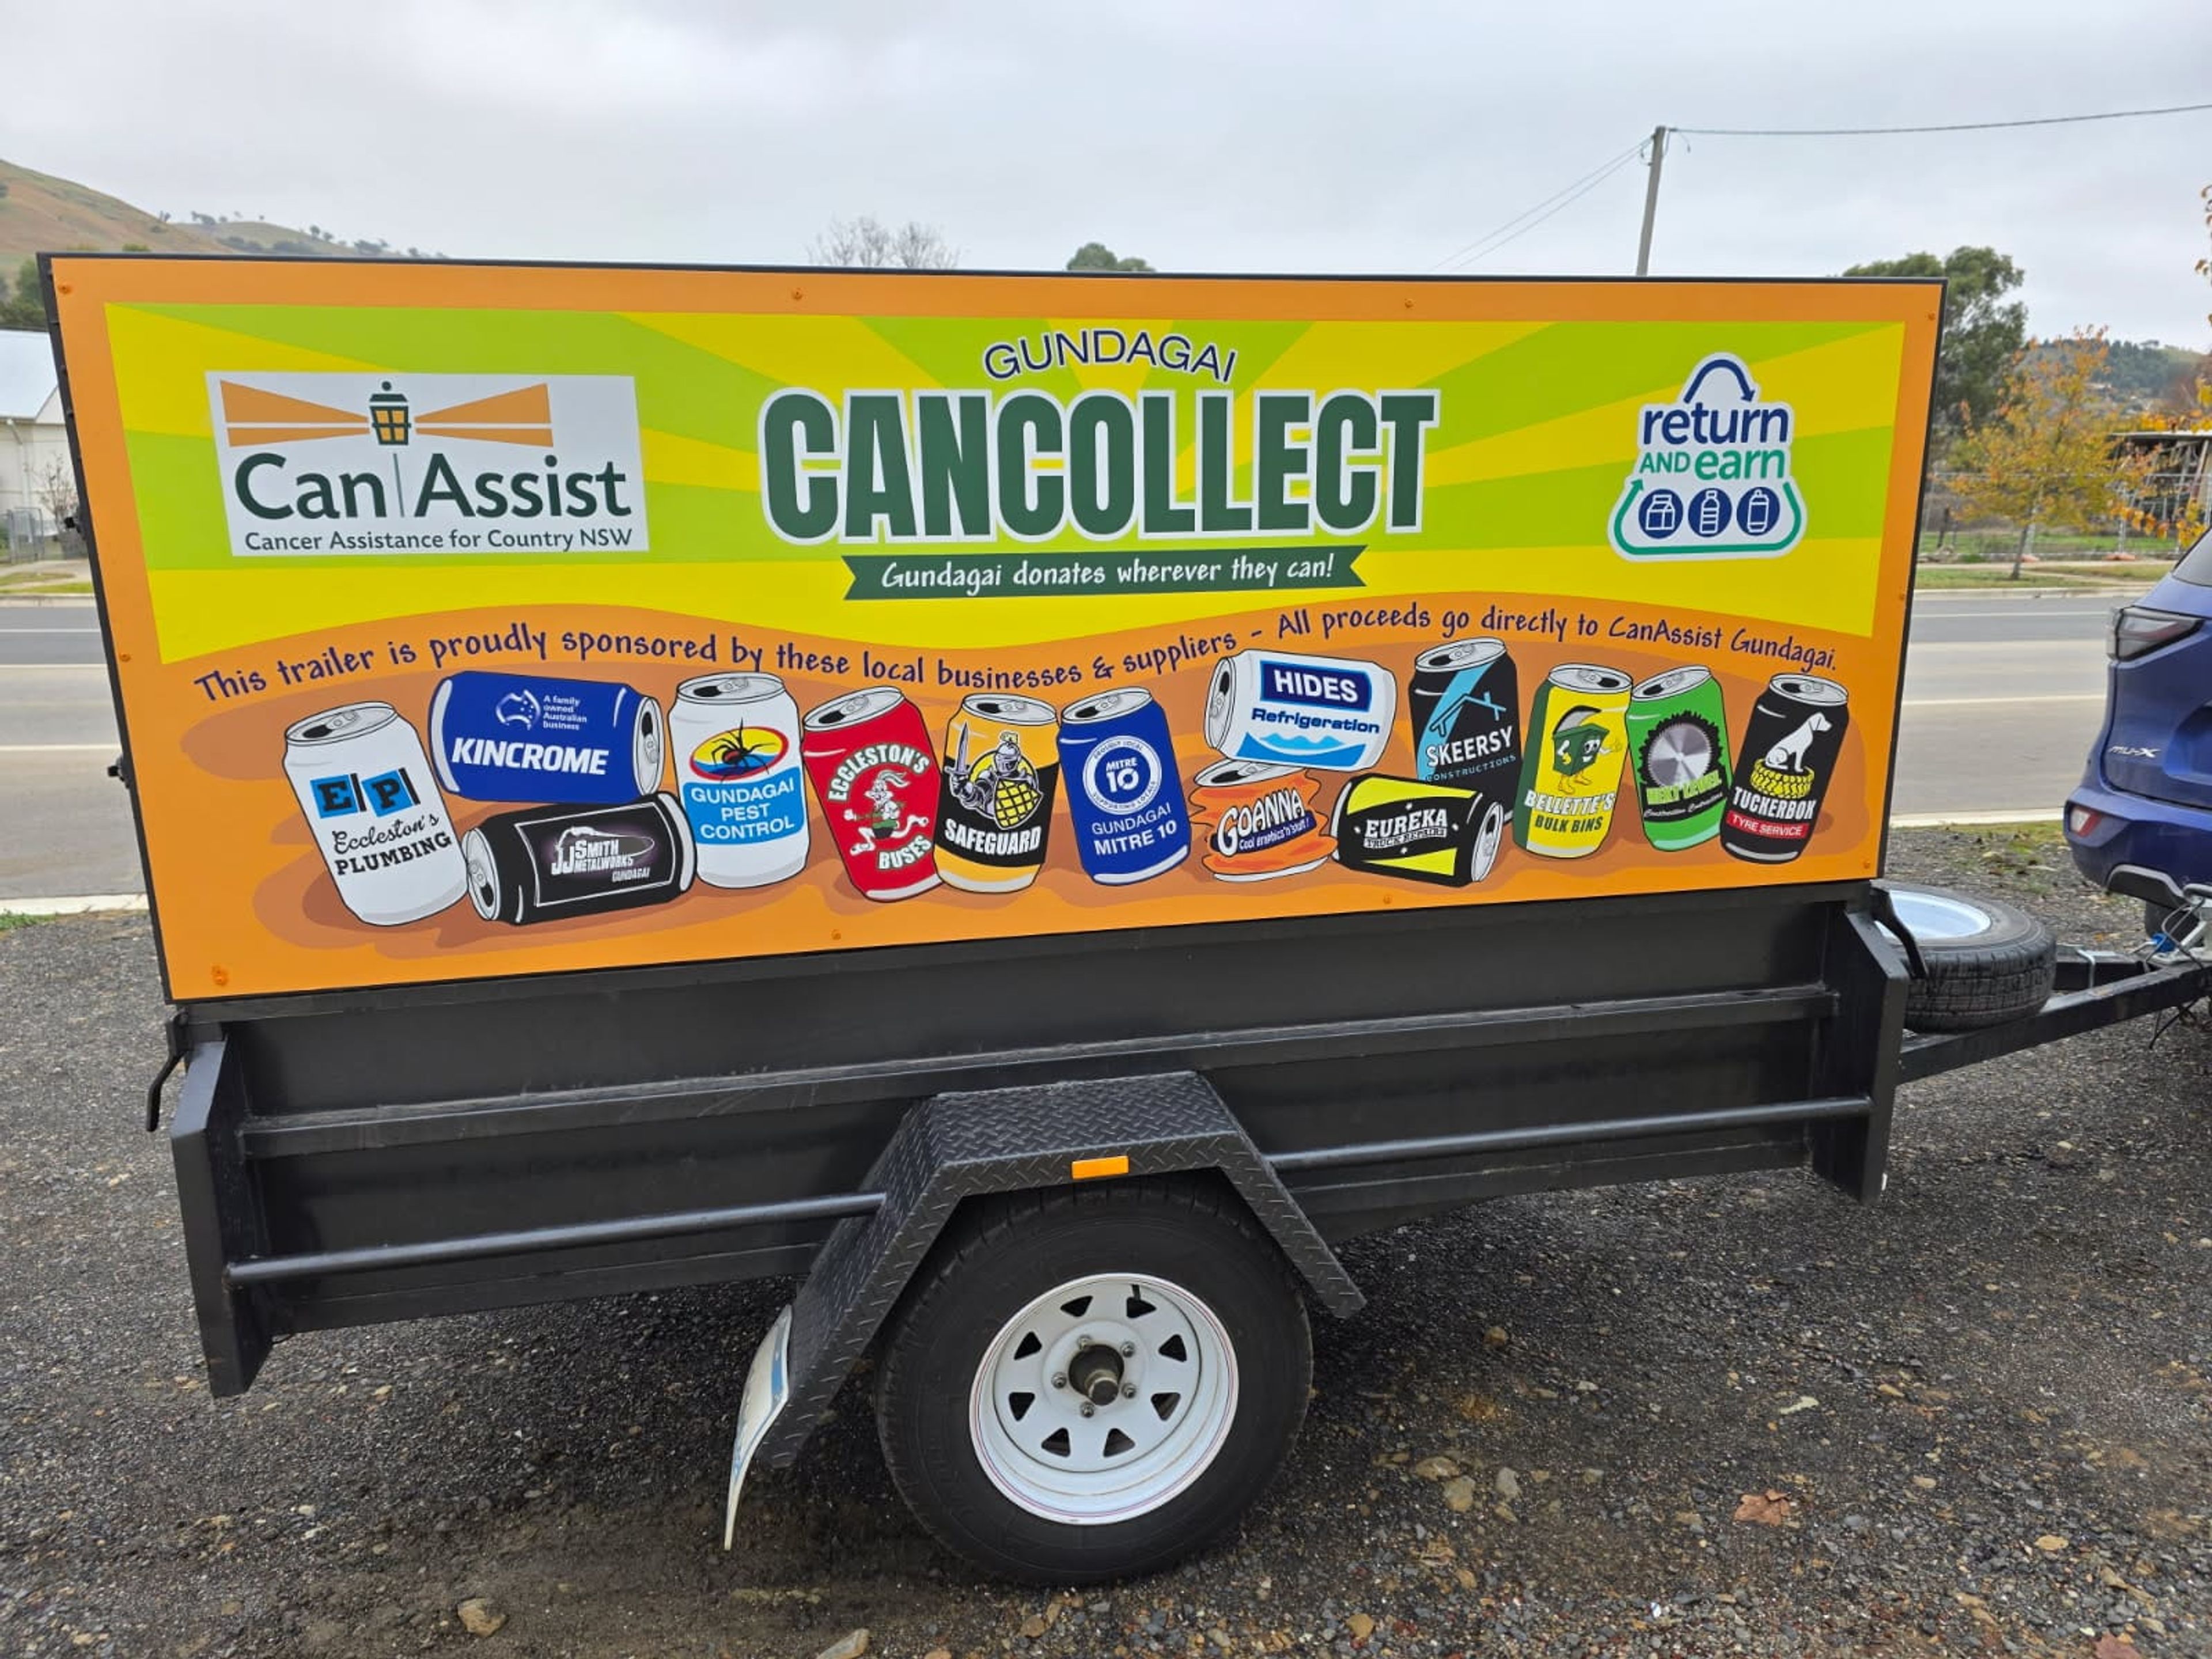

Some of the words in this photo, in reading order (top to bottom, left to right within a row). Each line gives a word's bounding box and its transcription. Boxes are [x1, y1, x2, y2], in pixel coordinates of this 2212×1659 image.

[985, 329, 1237, 382] GUNDAGAI
[1643, 403, 1789, 445] return
[760, 389, 1438, 542] CANCOLLECT
[1639, 452, 1690, 474] AND
[1694, 448, 1785, 480] earn
[234, 452, 387, 520] Can
[414, 452, 632, 518] Assist
[245, 531, 323, 551] Cancer
[329, 531, 444, 550] Assistance
[449, 529, 482, 548] for
[487, 529, 574, 552] Country
[579, 528, 633, 547] NSW
[882, 562, 1002, 596] Gundagai
[1013, 559, 1106, 585] donates
[1117, 558, 1222, 582] wherever
[1231, 555, 1278, 586] they
[1286, 554, 1335, 578] can!
[194, 669, 267, 701] This
[277, 646, 376, 687] trailer
[388, 641, 418, 665] is
[429, 622, 547, 669] proudly
[562, 631, 717, 662] sponsored
[731, 636, 764, 673] by
[775, 643, 850, 675] these
[863, 651, 924, 683] local
[937, 658, 1082, 690] businesses
[1092, 656, 1115, 680] &
[1123, 631, 1237, 675] suppliers
[1278, 608, 1311, 639] All
[1324, 601, 1431, 640] proceeds
[1441, 611, 1470, 638] go
[1481, 605, 1567, 642] directly
[1577, 613, 1598, 637] to
[1608, 616, 1722, 650] CanAssist
[1730, 628, 1837, 673] Gundagai.
[553, 695, 581, 707] family
[1273, 669, 1359, 703] HIDES
[543, 712, 588, 724] Australian
[1251, 707, 1380, 734] Refrigeration
[451, 737, 609, 775] KINCROME
[1426, 725, 1513, 768] SKEERSY
[828, 743, 931, 802] ECCLESTON'S
[1106, 757, 1138, 771] MITRE
[1106, 767, 1139, 793] 10
[1426, 754, 1517, 782] CONSTRUCTIONS
[691, 777, 795, 805] GUNDAGAI
[1524, 789, 1616, 816] BELLETTE'S
[1732, 786, 1817, 821] TUCKERBOX
[700, 816, 795, 840] CONTROL
[721, 802, 771, 822] PEST
[1091, 802, 1172, 836] GUNDAGAI
[1217, 787, 1306, 857] GOANNA
[1364, 808, 1448, 838] EUREKA
[1535, 815, 1569, 833] BULK
[1571, 815, 1604, 834] BINS
[1732, 813, 1759, 831] TYRE
[1759, 823, 1804, 836] SERVICE
[331, 813, 440, 855] Eccleston's
[575, 839, 619, 859] SMITH
[944, 818, 1042, 855] SAFEGUARD
[1094, 828, 1155, 857] MITRE
[1157, 819, 1177, 840] 10
[334, 831, 452, 876] PLUMBING
[574, 854, 634, 873] METALWORKS
[877, 835, 933, 870] BUSES
